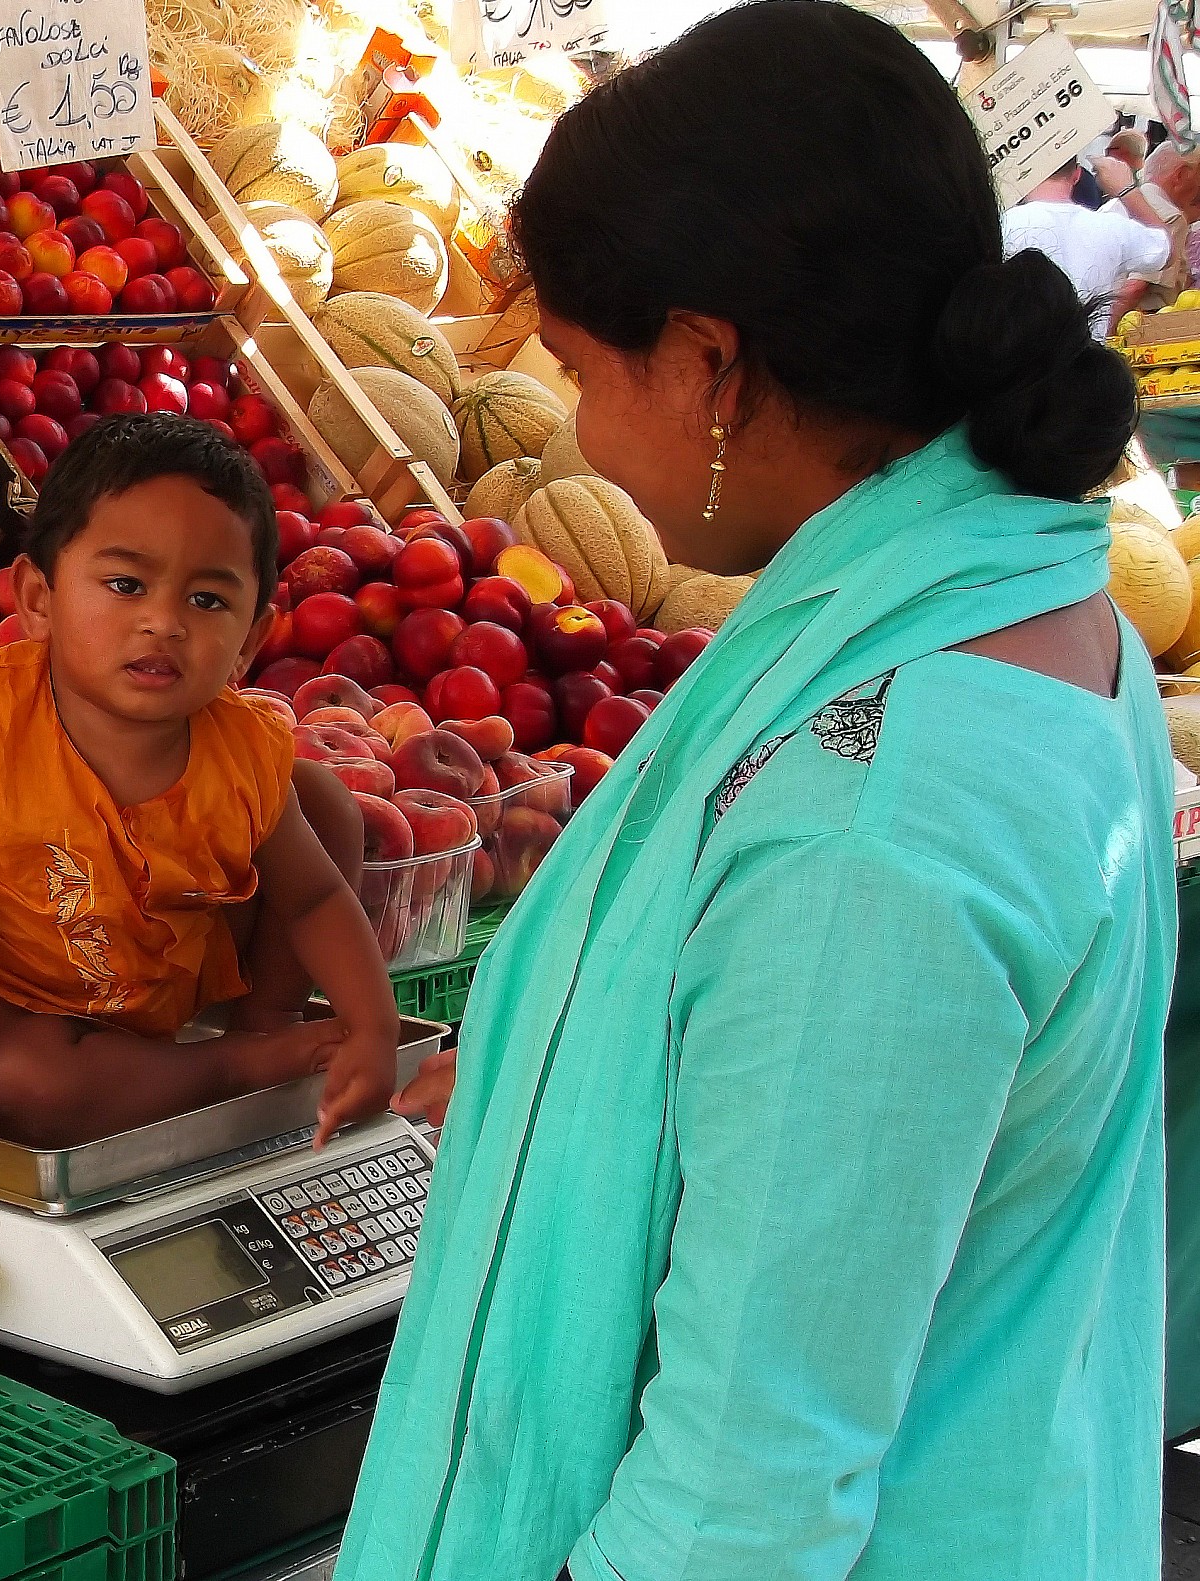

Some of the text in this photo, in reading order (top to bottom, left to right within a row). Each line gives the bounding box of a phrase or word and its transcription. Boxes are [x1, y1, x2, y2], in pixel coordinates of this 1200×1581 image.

[988, 126, 1031, 166] anco
[1033, 111, 1055, 128] n.
[1055, 79, 1083, 108] 56
[349, 1171, 359, 1185] 7
[367, 1165, 378, 1178] 8
[386, 1159, 398, 1173] 9
[368, 1193, 379, 1206] 4
[387, 1187, 398, 1201] 5
[404, 1181, 416, 1194] 6
[233, 1224, 250, 1235] kg
[385, 1216, 397, 1229] 1
[404, 1210, 417, 1223] 2
[169, 1318, 209, 1338] DIBAL
